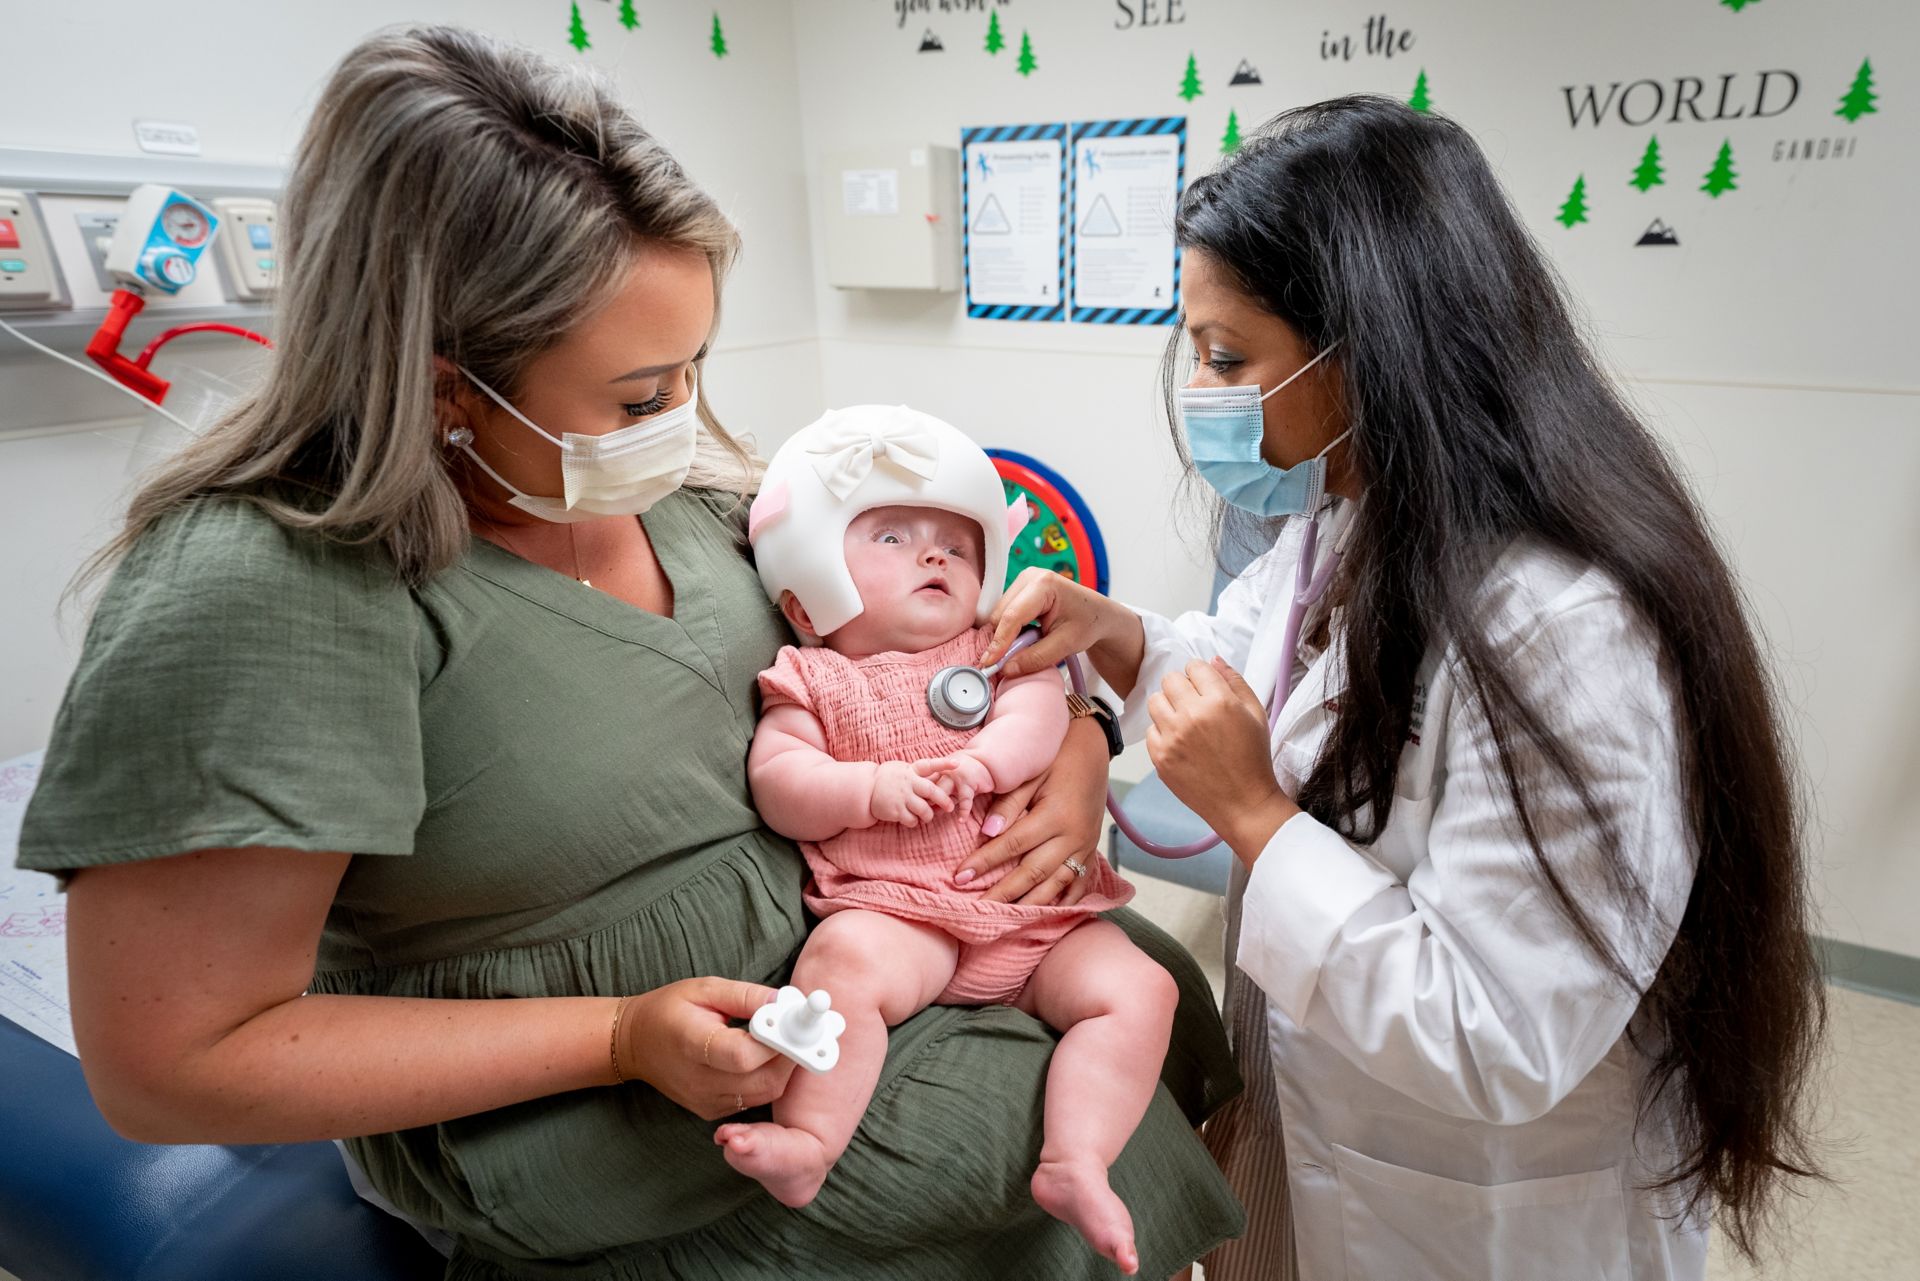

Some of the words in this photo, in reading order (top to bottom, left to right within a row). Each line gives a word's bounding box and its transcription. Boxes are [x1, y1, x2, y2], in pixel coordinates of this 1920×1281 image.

[1114, 0, 1187, 31] SEE
[1320, 29, 1358, 62] in
[1362, 14, 1417, 58] the
[1560, 69, 1802, 129] WORLD
[1771, 137, 1857, 162] GANDHI
